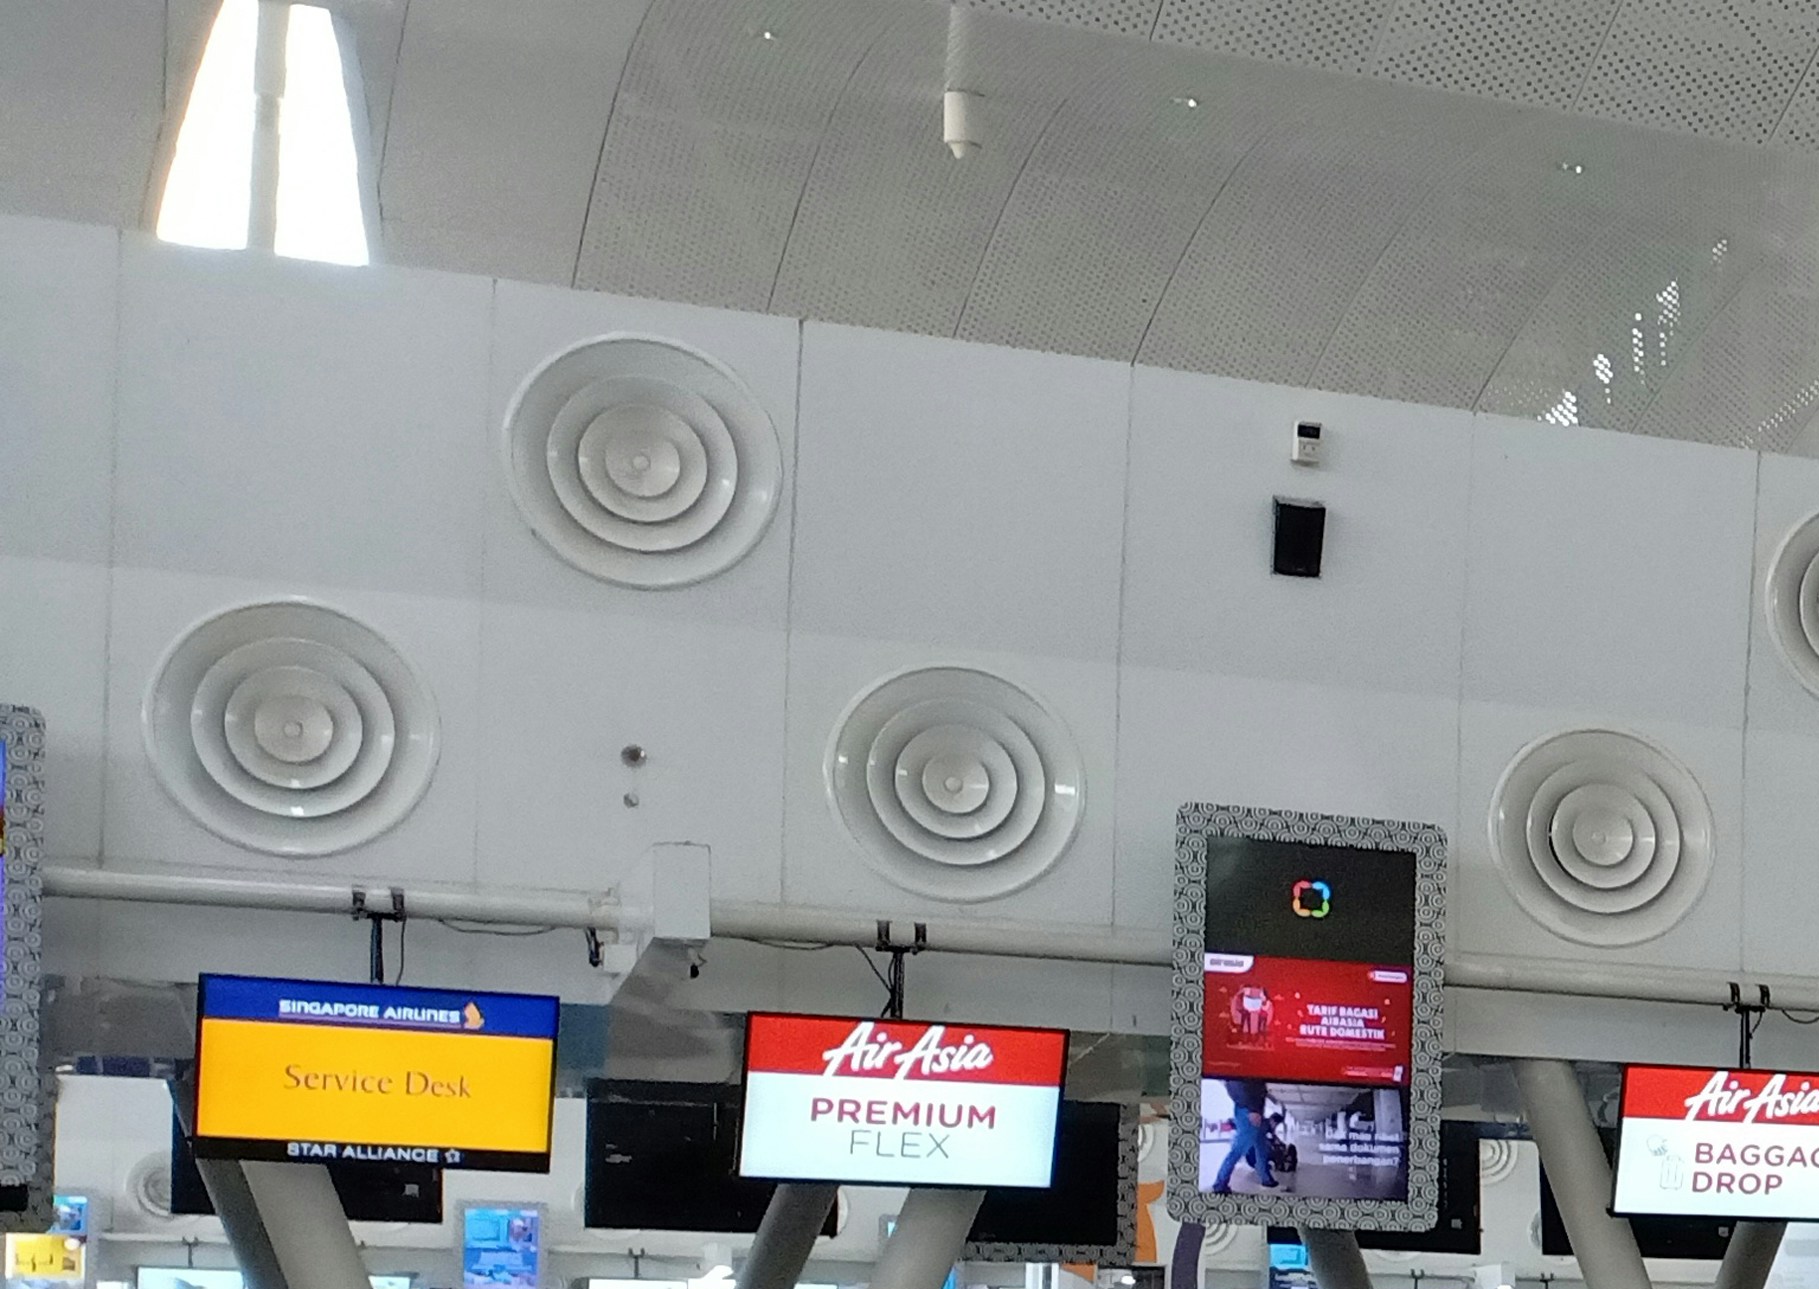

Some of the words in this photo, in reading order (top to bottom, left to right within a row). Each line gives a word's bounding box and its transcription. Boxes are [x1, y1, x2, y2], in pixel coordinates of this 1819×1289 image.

[278, 999, 379, 1019] SINGAPORE
[383, 1006, 460, 1025] AIRLINES
[1306, 1003, 1337, 1018] TARIF
[1339, 1005, 1379, 1020] BAGASI
[1299, 1024, 1329, 1037] RUTE
[1330, 1026, 1385, 1041] DOMESTIK
[283, 1063, 394, 1094] Service
[404, 1070, 472, 1098] Desk
[810, 1097, 996, 1129] PREMIUM
[287, 1142, 336, 1159] STAR
[342, 1144, 440, 1164] ALLIANCE
[850, 1129, 951, 1159] FLEX
[1691, 1171, 1783, 1195] DROP
